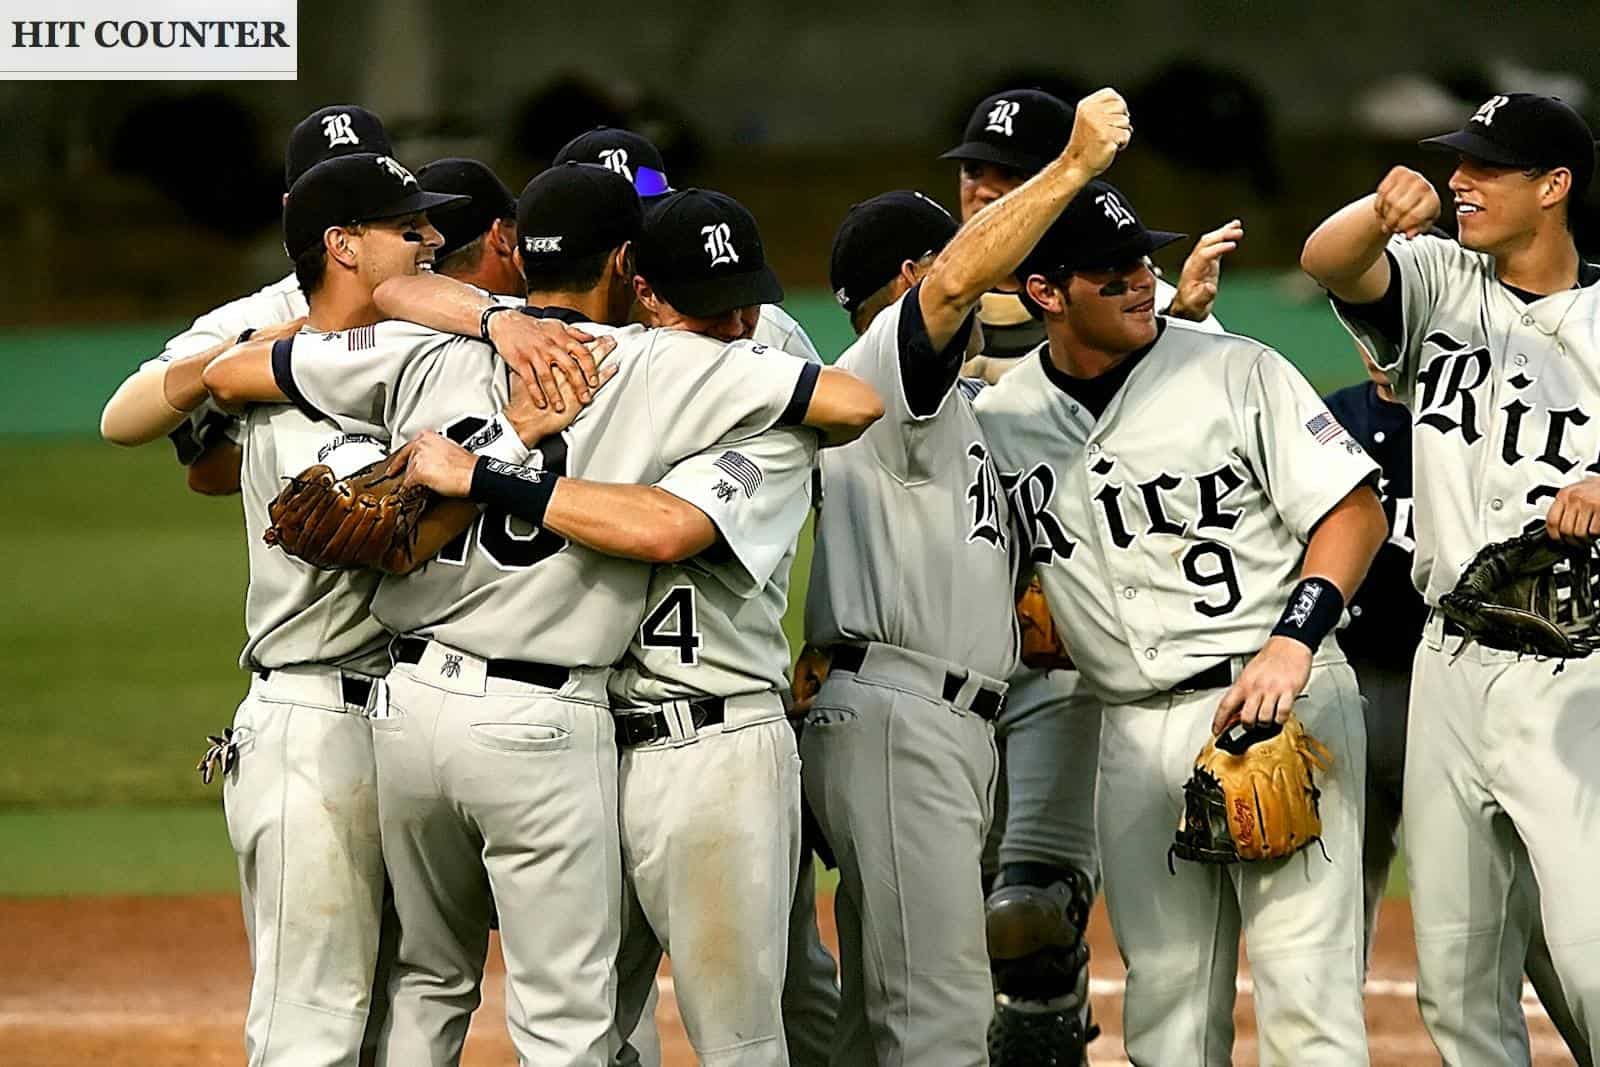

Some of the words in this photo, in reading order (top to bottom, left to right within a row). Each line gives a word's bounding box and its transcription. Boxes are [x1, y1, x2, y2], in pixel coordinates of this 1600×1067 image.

[321, 112, 360, 149] R
[984, 99, 1020, 137] R
[700, 222, 739, 268] R
[1414, 330, 1600, 475] Ric
[999, 455, 1248, 567] Rice
[1180, 541, 1244, 618] 9
[639, 585, 703, 666] 4
